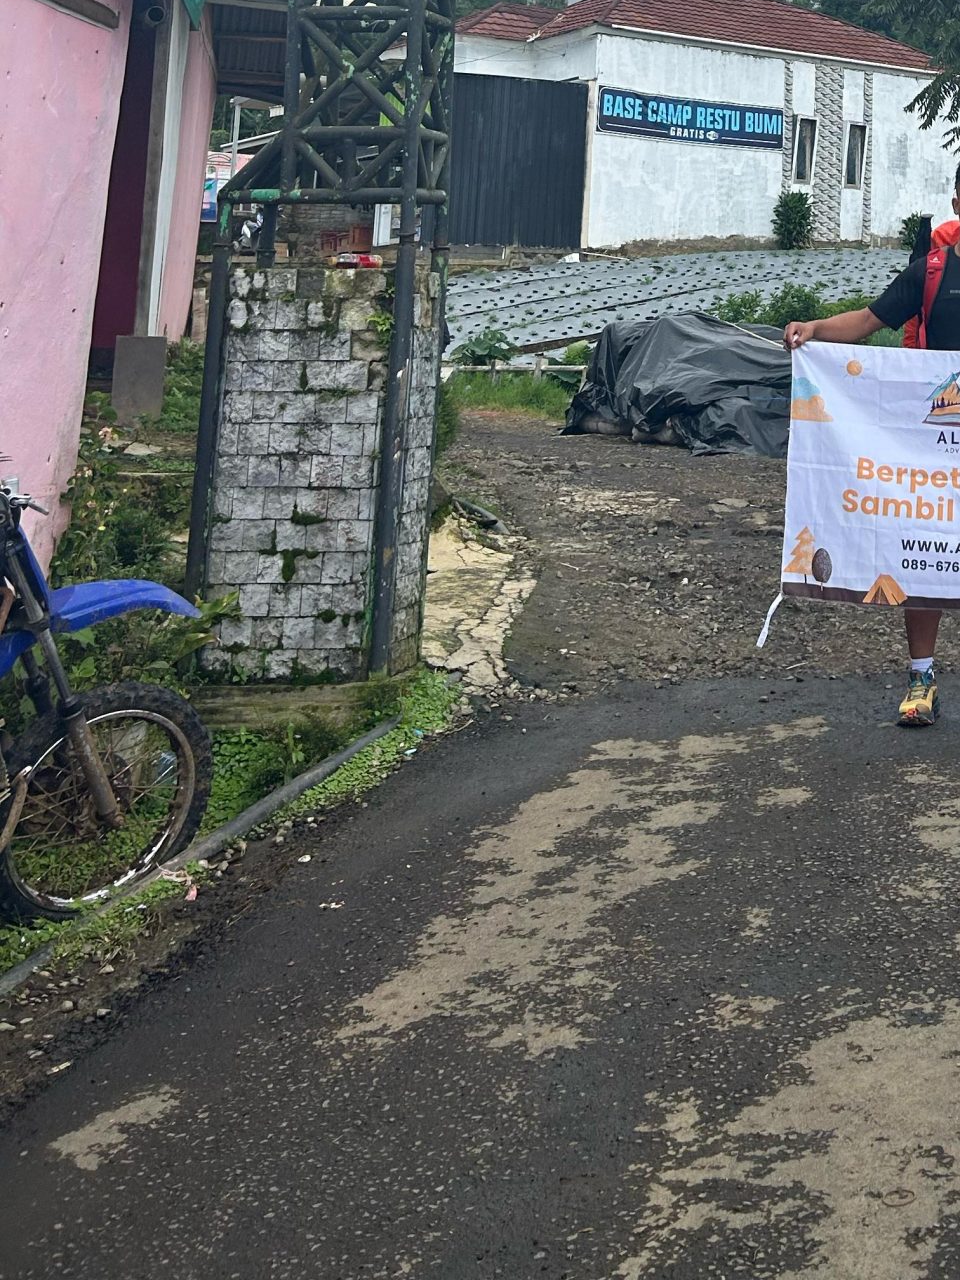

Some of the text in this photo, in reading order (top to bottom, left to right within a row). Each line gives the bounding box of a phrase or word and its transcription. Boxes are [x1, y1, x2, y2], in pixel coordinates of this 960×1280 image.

[602, 93, 782, 135] BASE CAMP RESTU BUMI
[669, 126, 705, 140] GRATIS
[841, 488, 954, 522] Sambil
